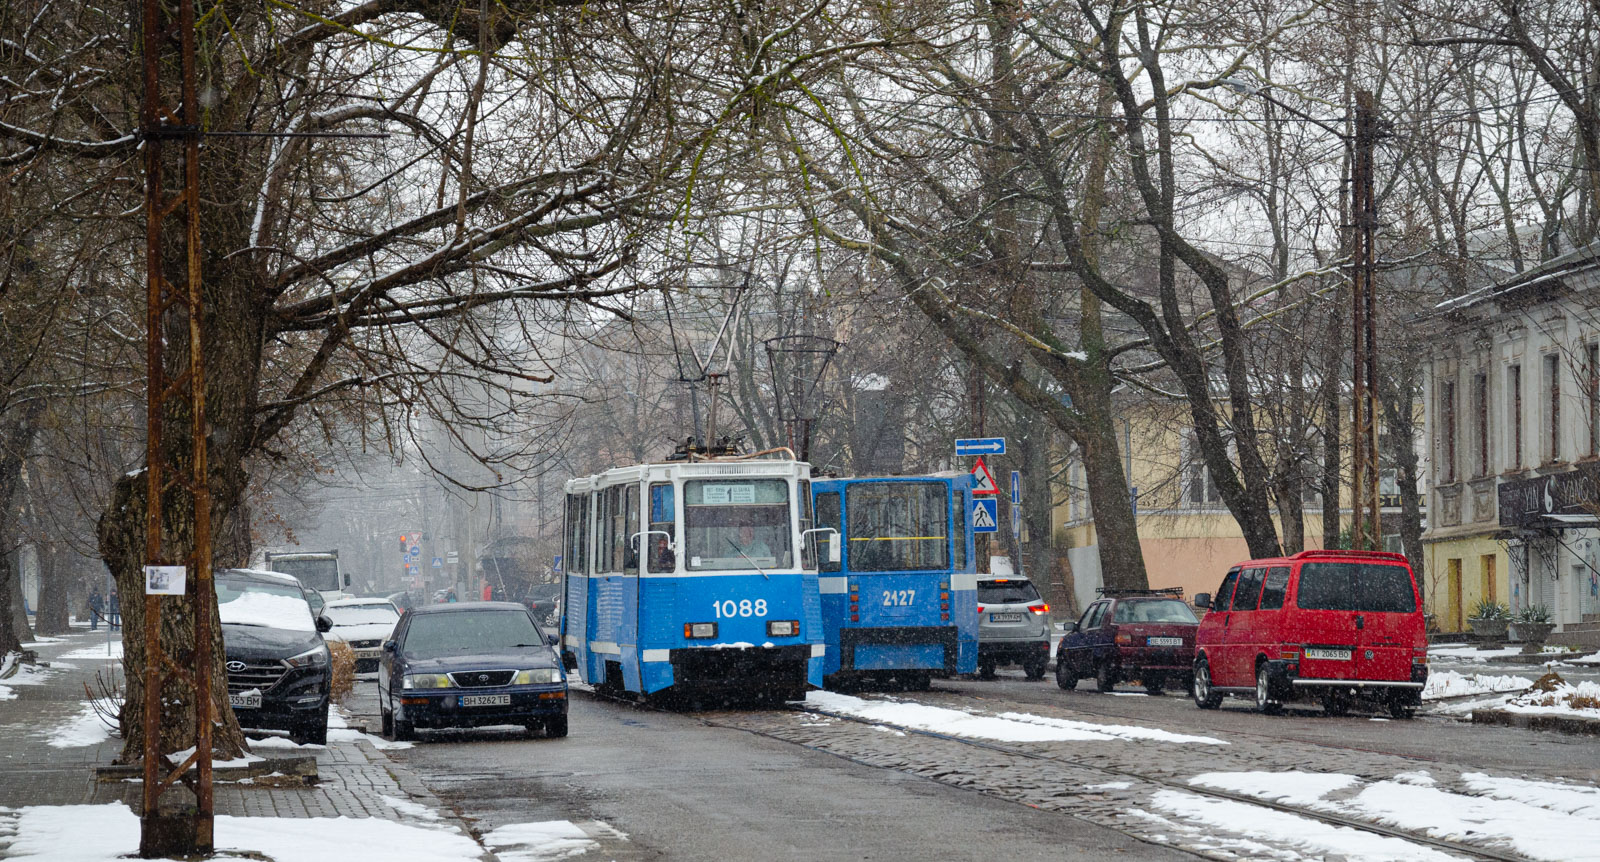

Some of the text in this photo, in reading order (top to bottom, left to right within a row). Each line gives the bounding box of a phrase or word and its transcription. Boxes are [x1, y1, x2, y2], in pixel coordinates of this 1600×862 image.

[726, 487, 732, 502] 1
[1523, 485, 1539, 511] YIN
[1562, 476, 1589, 504] YANG
[882, 590, 916, 606] 2127
[712, 598, 768, 618] 1088
[1321, 650, 1338, 658] 2065
[246, 696, 260, 706] BM
[463, 695, 510, 706] BH 3262 TE
